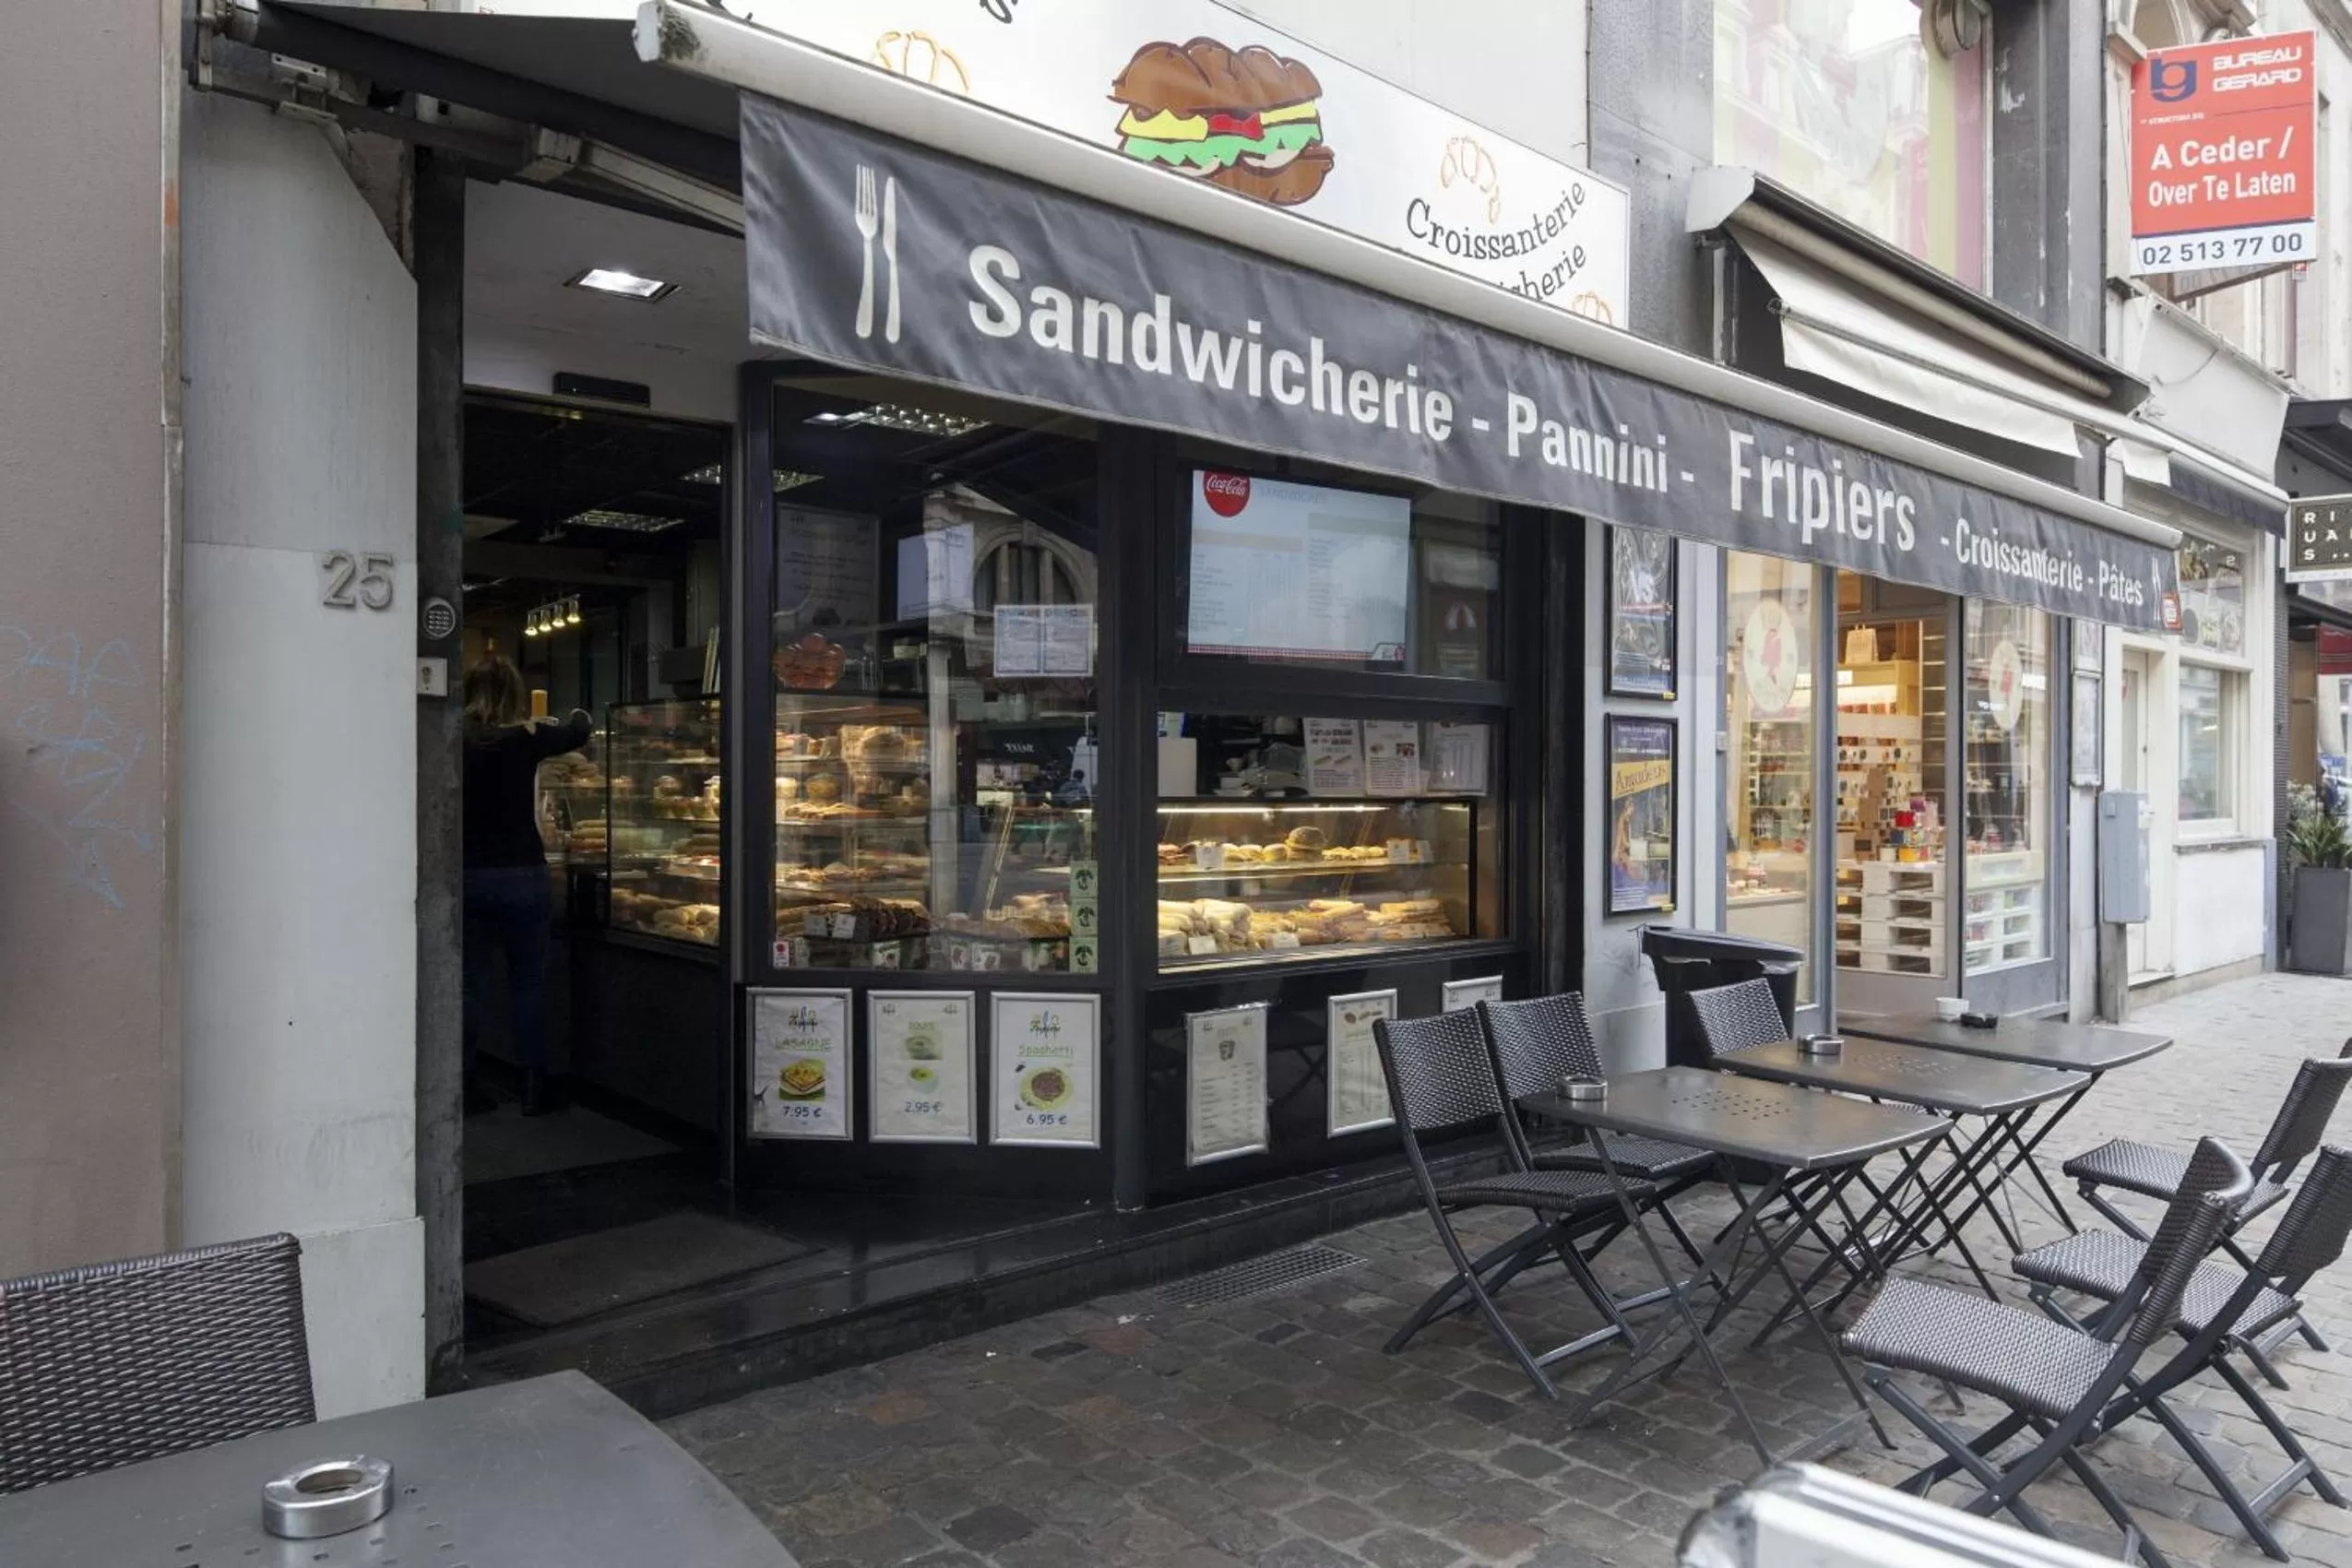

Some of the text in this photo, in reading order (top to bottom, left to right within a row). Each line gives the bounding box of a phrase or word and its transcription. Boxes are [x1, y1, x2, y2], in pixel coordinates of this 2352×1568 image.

[2213, 46, 2302, 70] BUREAU
[2213, 67, 2302, 92] GERARD
[2151, 144, 2173, 170] A
[2180, 136, 2272, 167] Ceder
[2148, 171, 2296, 208] Over Te Laten
[1407, 182, 1586, 260] Croissanterie
[2143, 233, 2302, 266] 02 513 77 00
[968, 244, 1454, 442] Sandwicherie
[1506, 391, 1668, 493] Pannini
[1728, 429, 1917, 552] Fripiers
[1955, 518, 2084, 592] Croissanterie
[2098, 560, 2144, 607] Pâtes
[322, 550, 395, 611] 25
